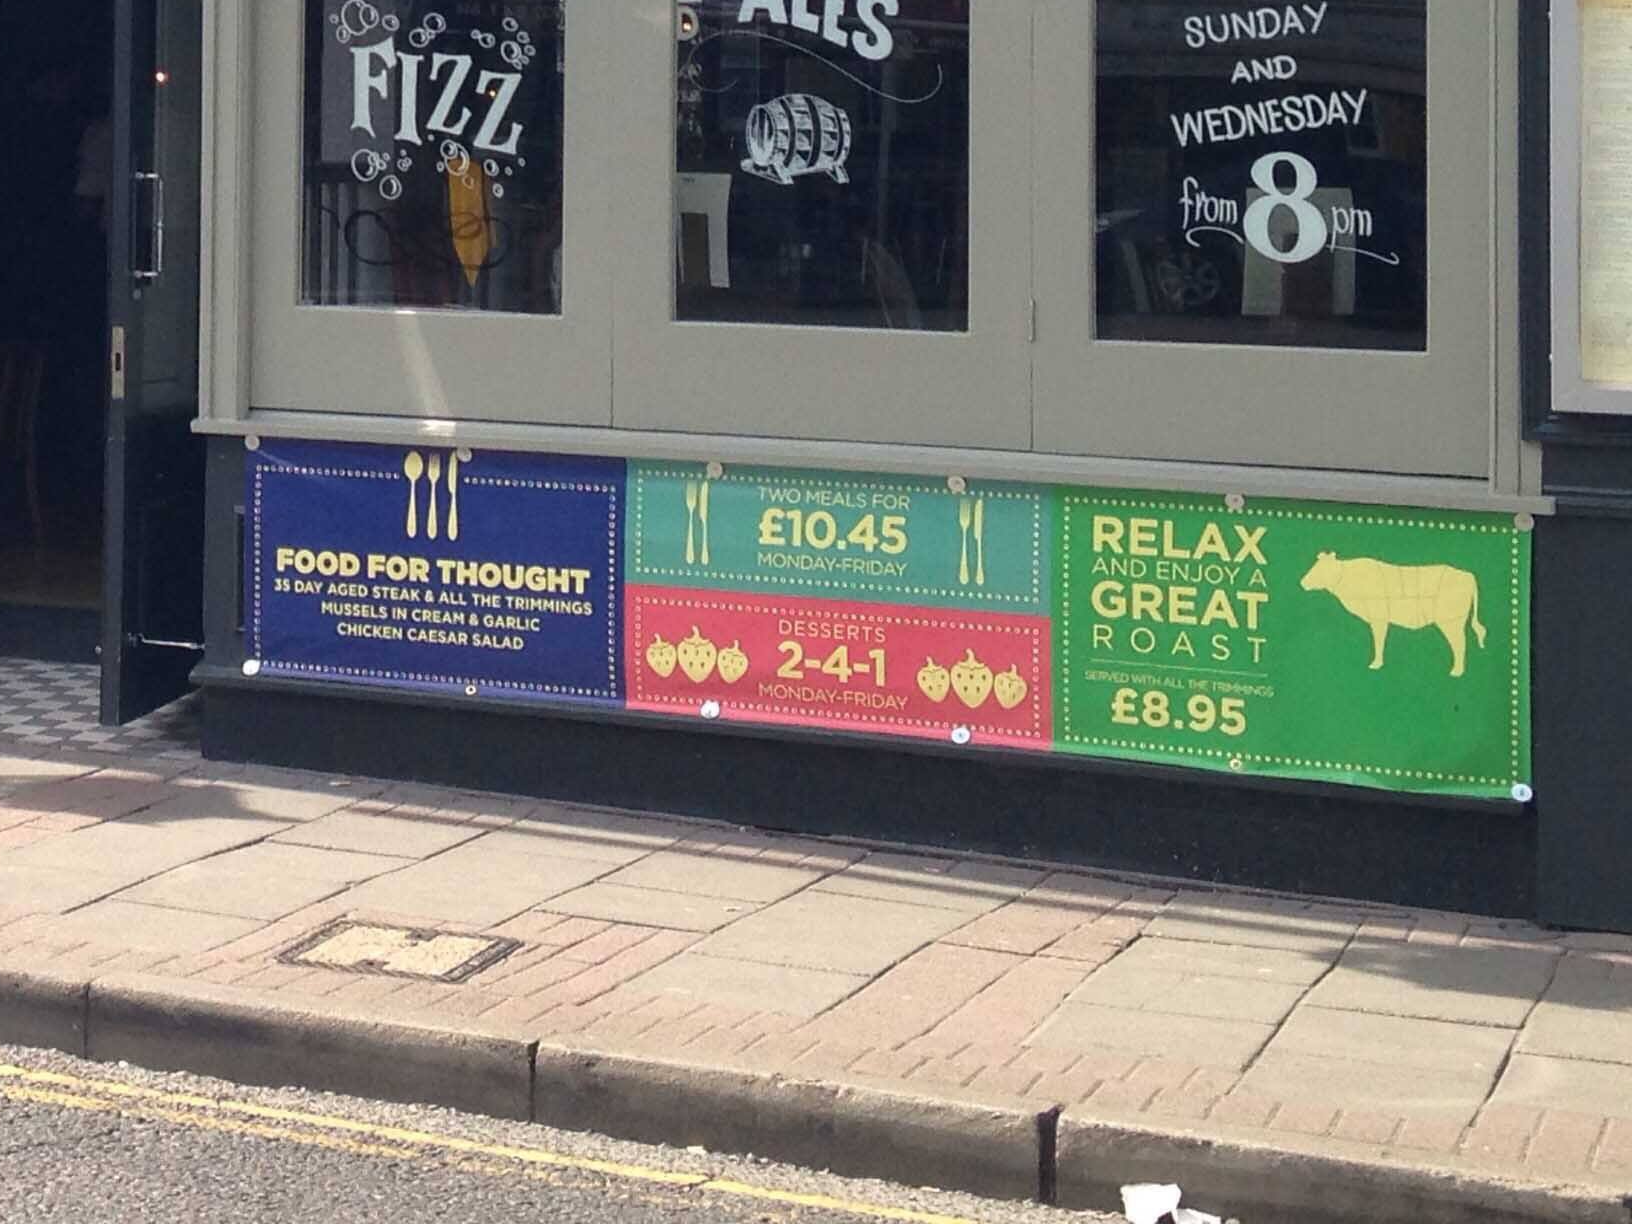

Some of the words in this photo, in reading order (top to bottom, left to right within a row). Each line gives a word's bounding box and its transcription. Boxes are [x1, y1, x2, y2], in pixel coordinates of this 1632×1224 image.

[1183, 1, 1329, 49] SUNDAY
[1230, 54, 1298, 84] AND
[349, 37, 524, 155] FIZZ
[1170, 88, 1368, 148] WEDNESDAY
[1179, 176, 1239, 229] from
[1242, 150, 1327, 263] 8
[1329, 204, 1374, 252] pm
[758, 485, 802, 506] TWO
[805, 488, 868, 510] MEALS
[871, 493, 910, 512] FOR
[757, 507, 908, 555] £10.45
[1092, 514, 1267, 565] RELAX
[276, 547, 361, 577] FOOD
[367, 554, 430, 583] FOR
[436, 559, 591, 594] THOUGHT
[756, 551, 908, 578] MONDAY-FRIDAY
[1091, 557, 1147, 579] AND
[1155, 560, 1240, 586] ENJOY
[1248, 568, 1267, 587] A
[274, 578, 291, 592] 35
[294, 580, 323, 595] DAY
[327, 582, 368, 598] AGED
[372, 586, 420, 602] STEAK
[424, 590, 435, 604] &
[439, 590, 467, 606] ALL
[471, 593, 502, 609] THE
[505, 595, 593, 616] TRIMMINGS
[321, 601, 388, 620] MUSSELS
[391, 606, 408, 621] IN
[411, 609, 466, 626] CREAM
[469, 613, 480, 626] &
[483, 614, 541, 632] GARLIC
[1091, 579, 1269, 631] GREAT
[337, 622, 403, 641] CHICKEN
[406, 627, 469, 646] CAESAR
[471, 633, 524, 650] SALAD
[777, 619, 887, 643] DESSERTS
[1092, 622, 1268, 664] ROAST
[776, 639, 886, 687] 2-4-1
[1130, 673, 1161, 687] WITH
[1161, 677, 1185, 690] ALL
[1187, 679, 1208, 691] THE
[758, 683, 908, 711] MONDAY-FRIDAY
[1110, 687, 1247, 737] £8.95
